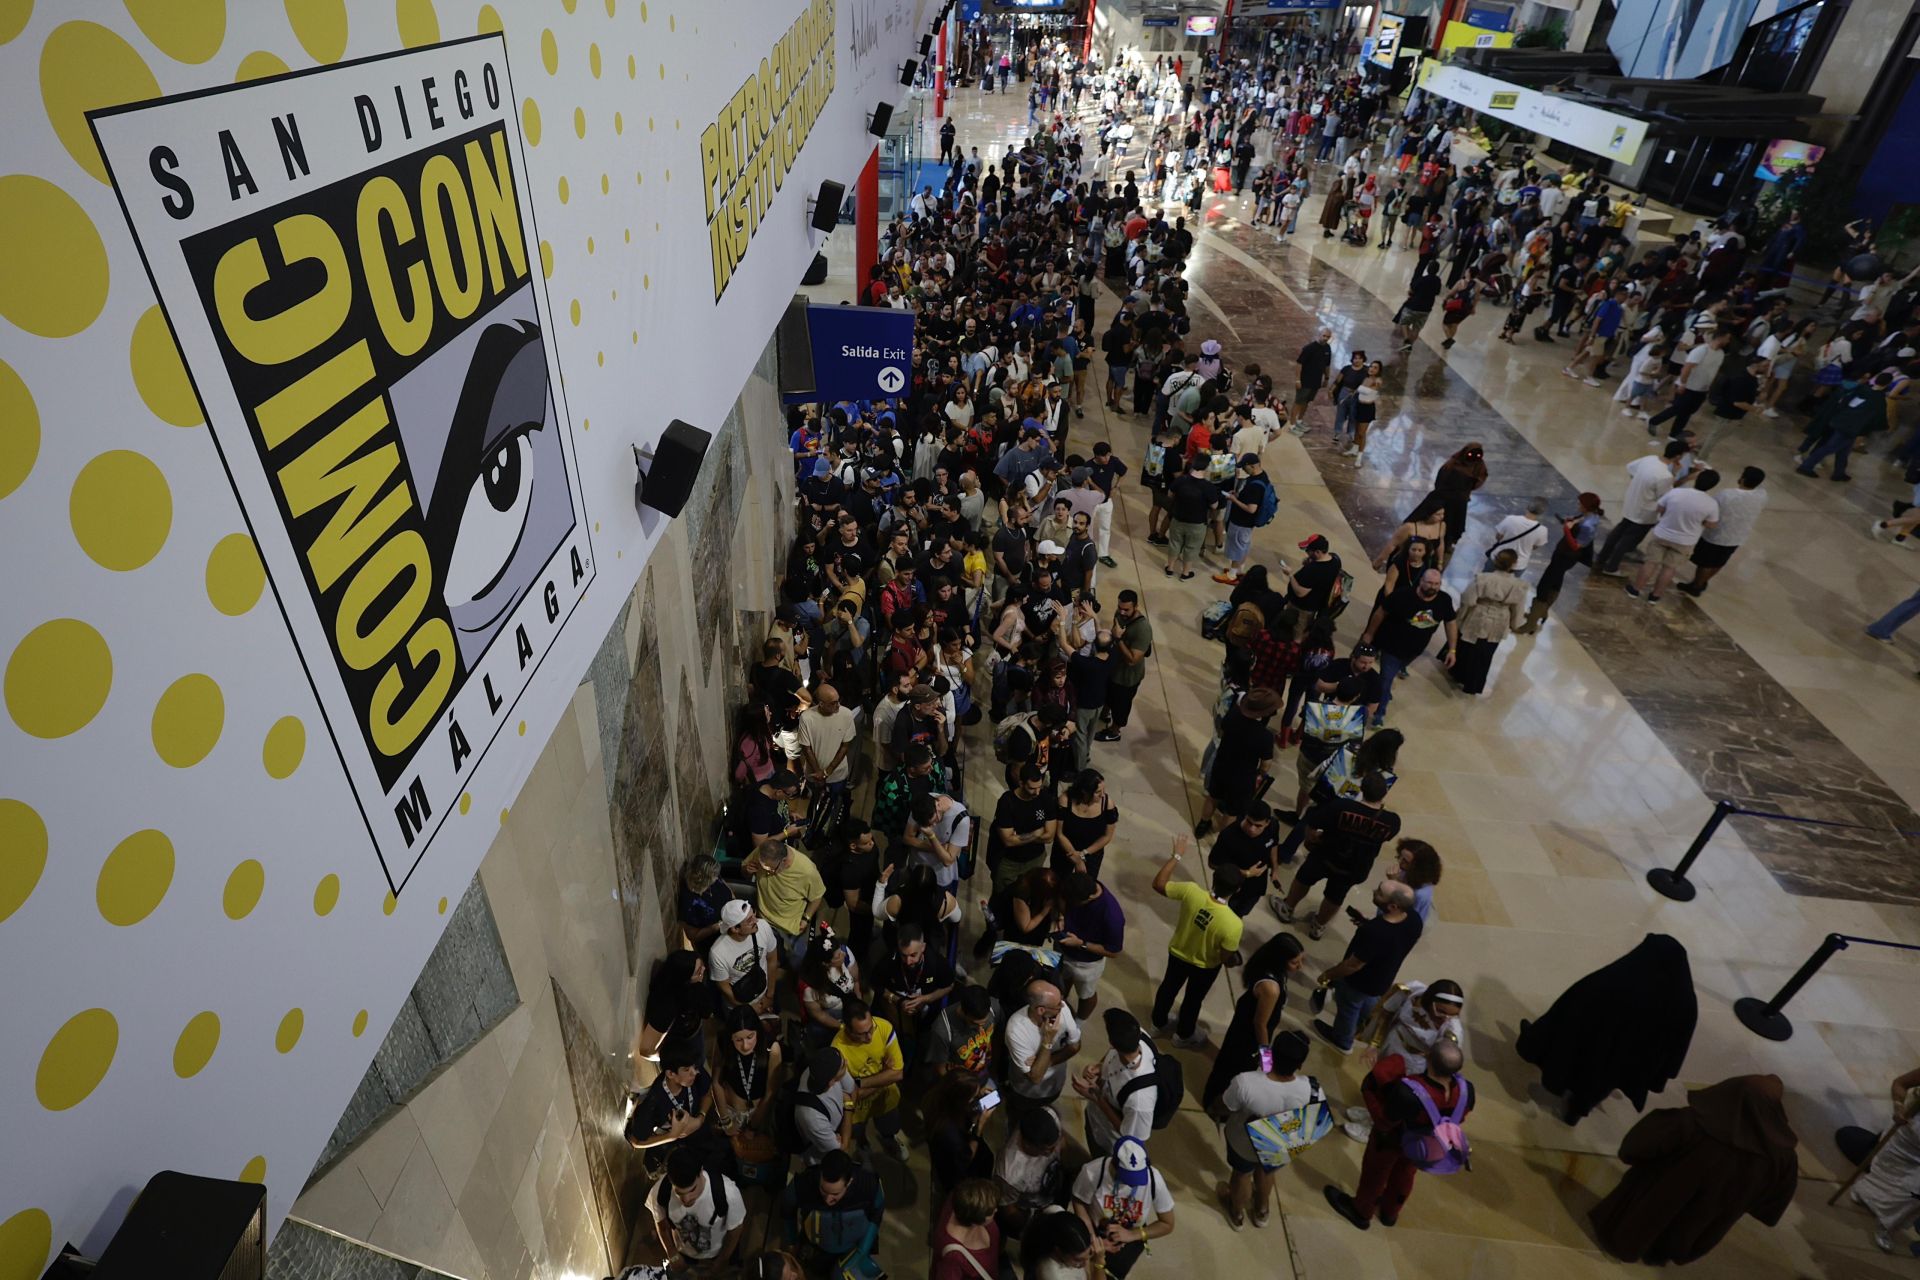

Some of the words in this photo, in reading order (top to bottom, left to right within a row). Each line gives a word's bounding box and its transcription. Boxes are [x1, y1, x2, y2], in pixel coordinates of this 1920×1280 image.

[149, 113, 311, 220] SAN
[354, 62, 501, 153] DIEGO
[700, 0, 835, 226] PATROCINADORES
[710, 38, 835, 306] INSTITUCIONALES
[356, 130, 528, 356] CON
[841, 345, 880, 359] Salida
[883, 347, 906, 361] Exit
[213, 213, 457, 757] COMIC
[394, 544, 585, 849] MÁLAGA
